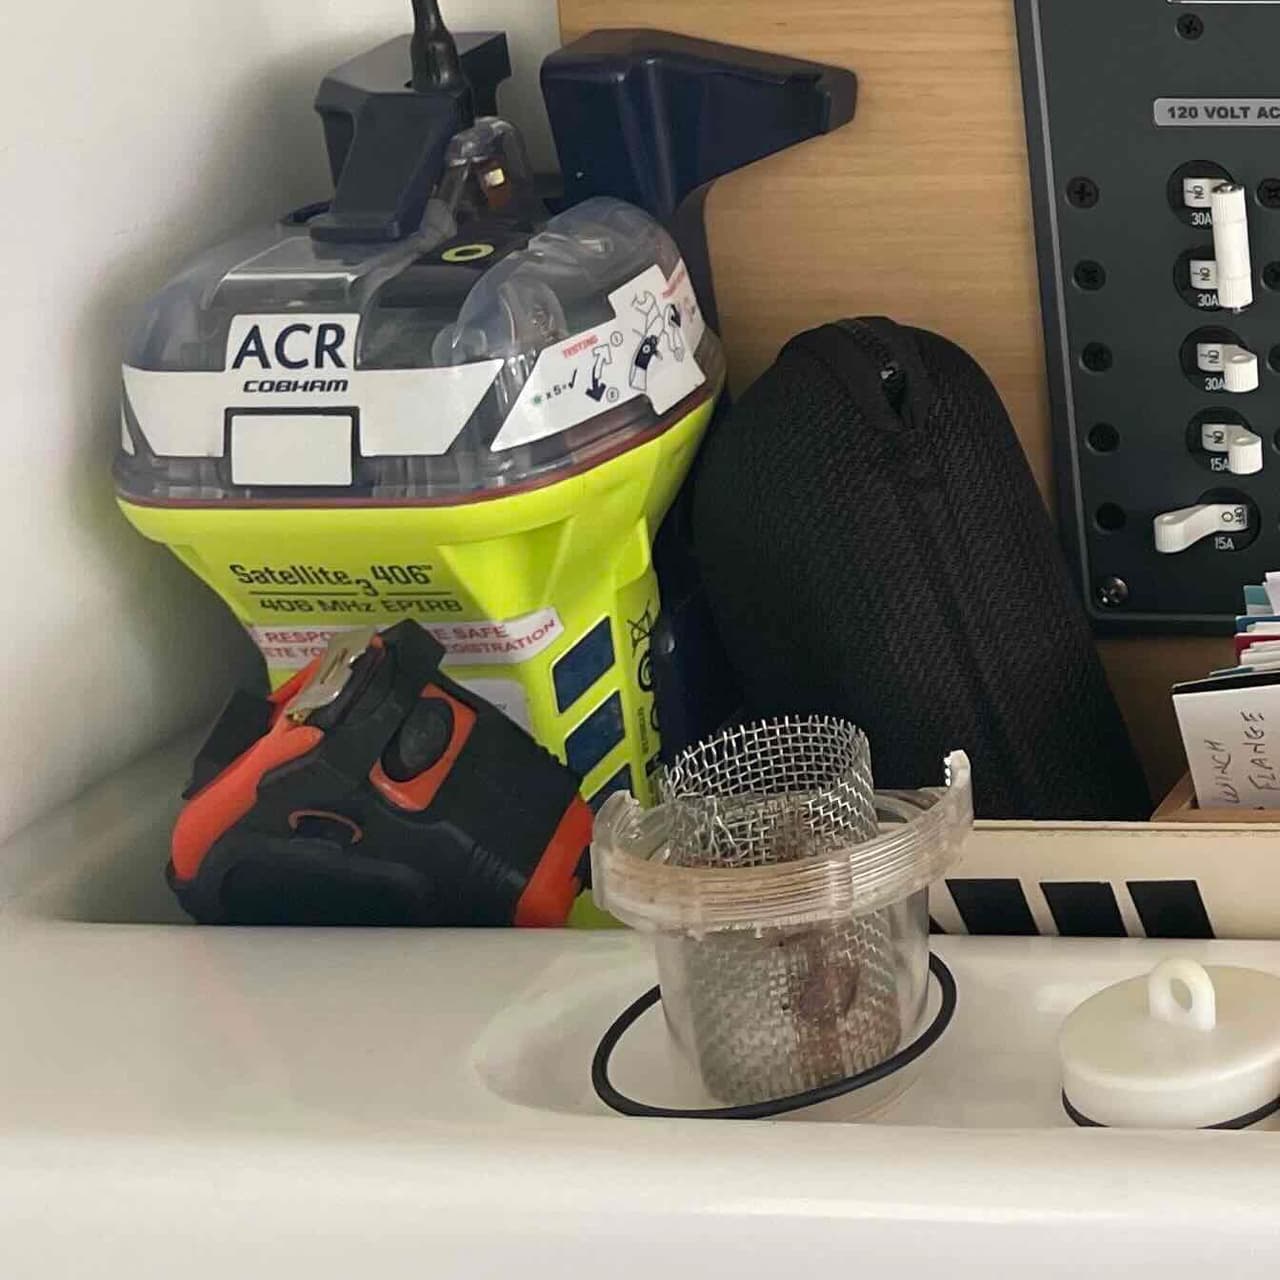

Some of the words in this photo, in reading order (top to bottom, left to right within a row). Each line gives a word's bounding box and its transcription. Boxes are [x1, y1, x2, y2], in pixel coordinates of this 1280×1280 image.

[1167, 106, 1199, 119] 120
[1204, 106, 1250, 119] VOLT
[1256, 106, 1280, 119] AC
[1191, 212, 1213, 225] 30A
[1197, 293, 1219, 306] 30A
[232, 323, 347, 369] ACR
[243, 379, 349, 392] COBHAM
[1214, 537, 1235, 550] 15A
[318, 600, 376, 613] MHz
[382, 600, 463, 612] EPIRB
[452, 624, 509, 639] SAFE
[1204, 739, 1241, 804] WINCH
